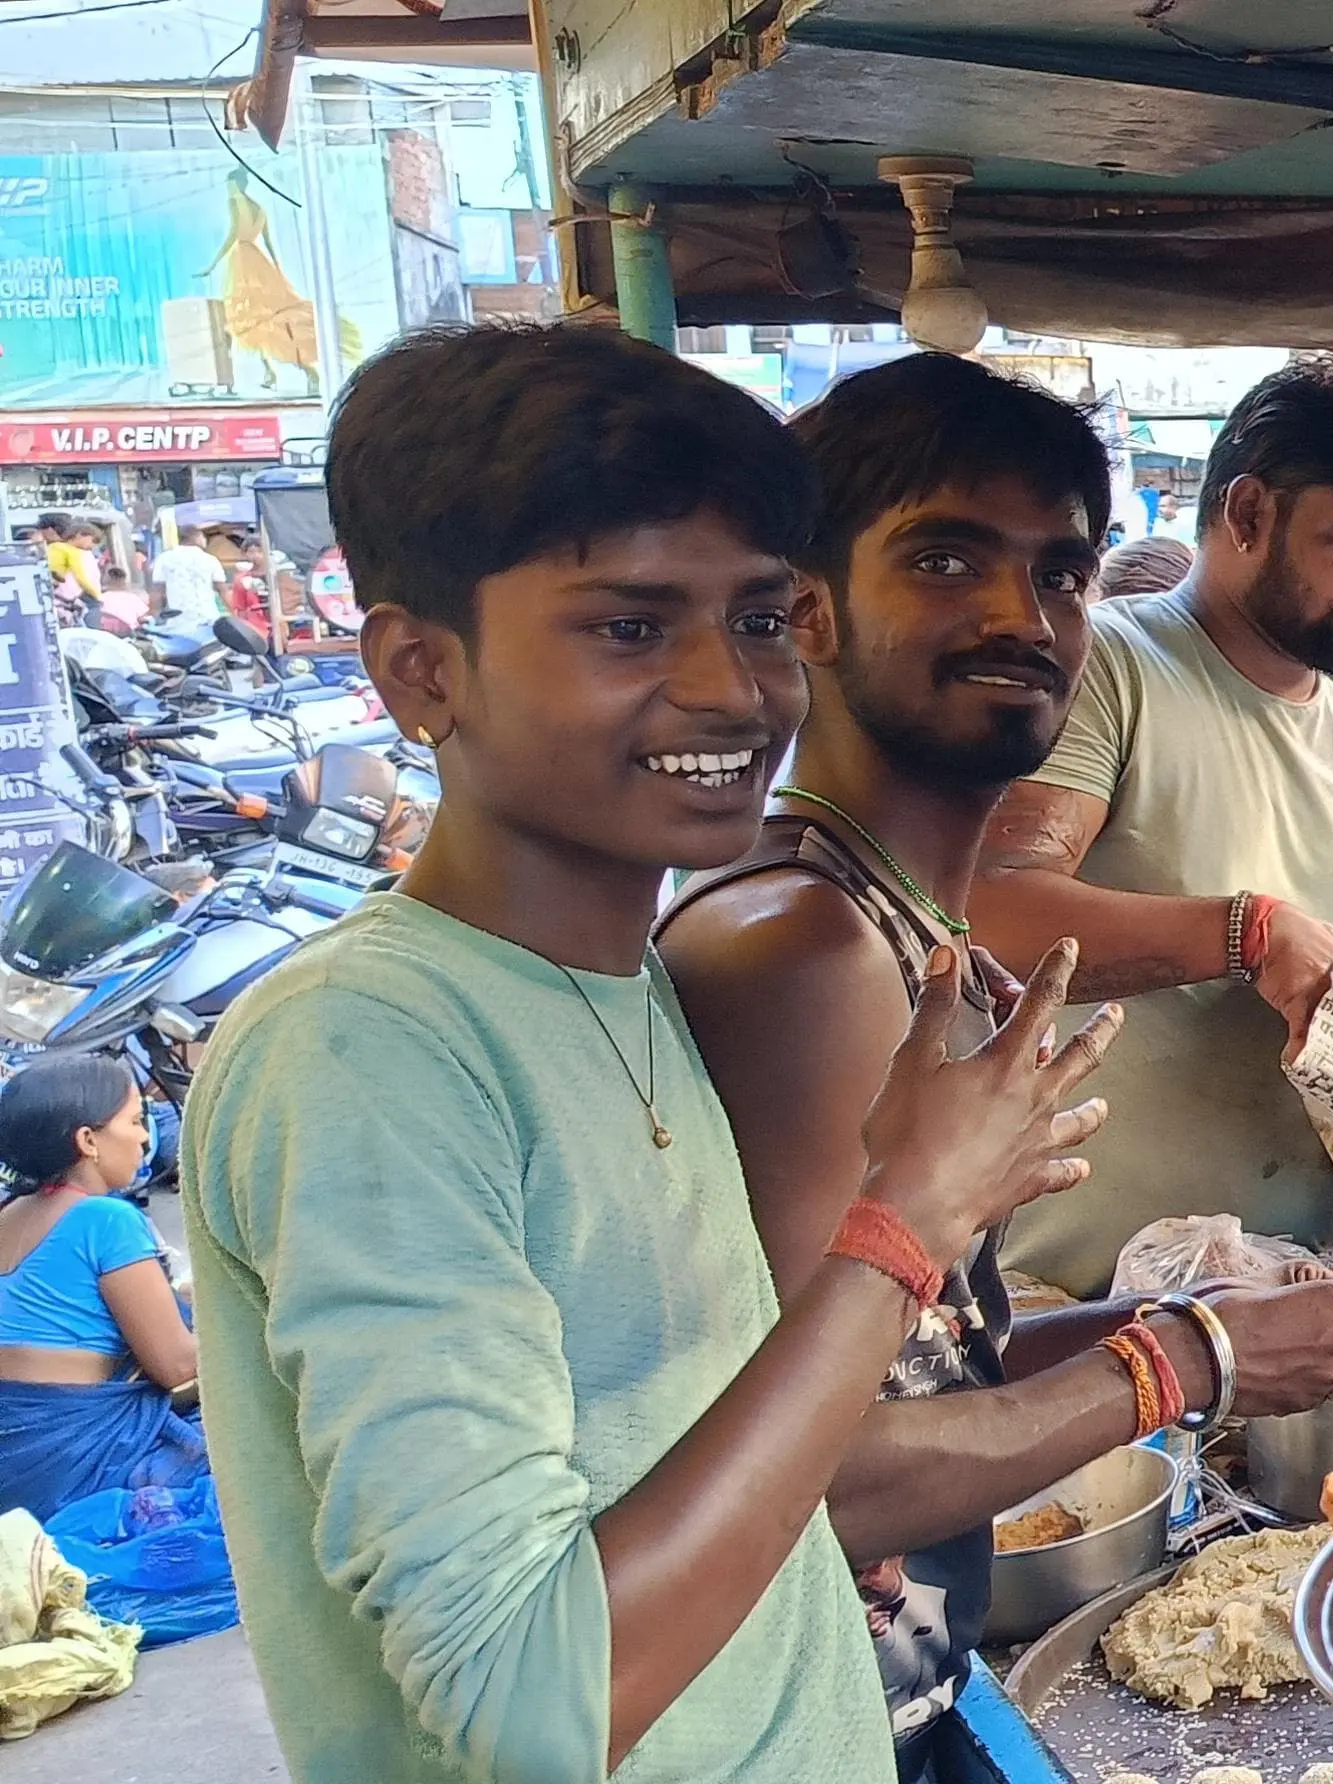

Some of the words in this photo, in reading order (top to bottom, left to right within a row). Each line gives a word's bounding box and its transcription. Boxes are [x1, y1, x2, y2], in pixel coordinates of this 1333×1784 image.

[51, 276, 120, 297] INNER
[0, 298, 105, 319] TRENGTH
[51, 427, 113, 451] V.I.P.
